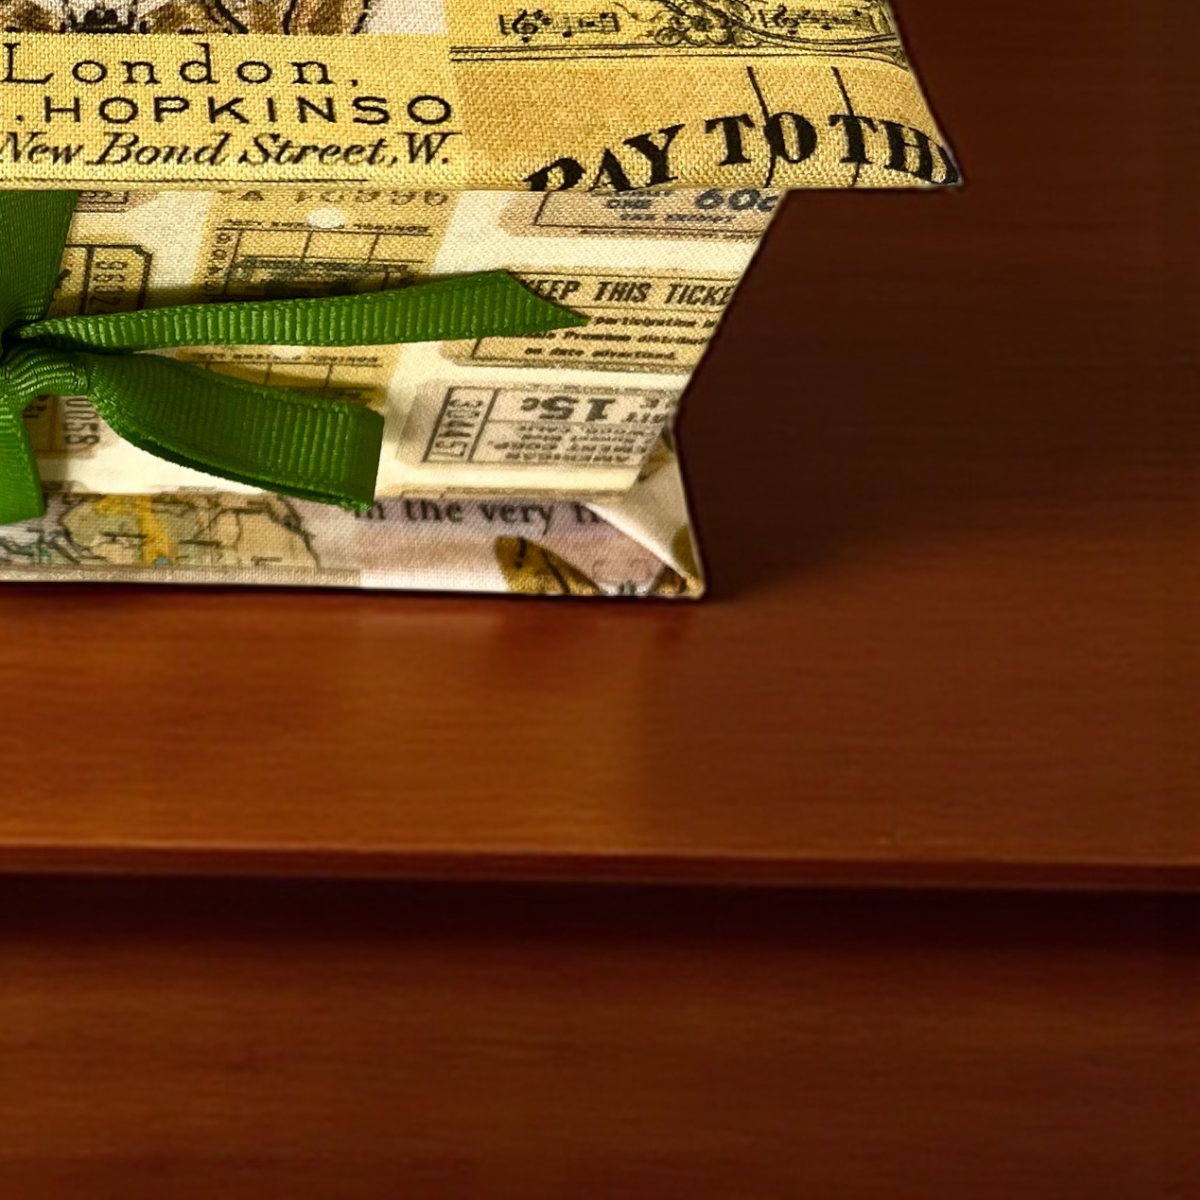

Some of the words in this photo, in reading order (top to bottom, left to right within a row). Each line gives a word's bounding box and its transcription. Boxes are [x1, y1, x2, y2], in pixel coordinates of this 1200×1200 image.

[1, 42, 358, 87] London.
[86, 131, 231, 166] Bond
[523, 123, 686, 192] PAY
[594, 281, 652, 302] THIS
[478, 501, 555, 536] very
